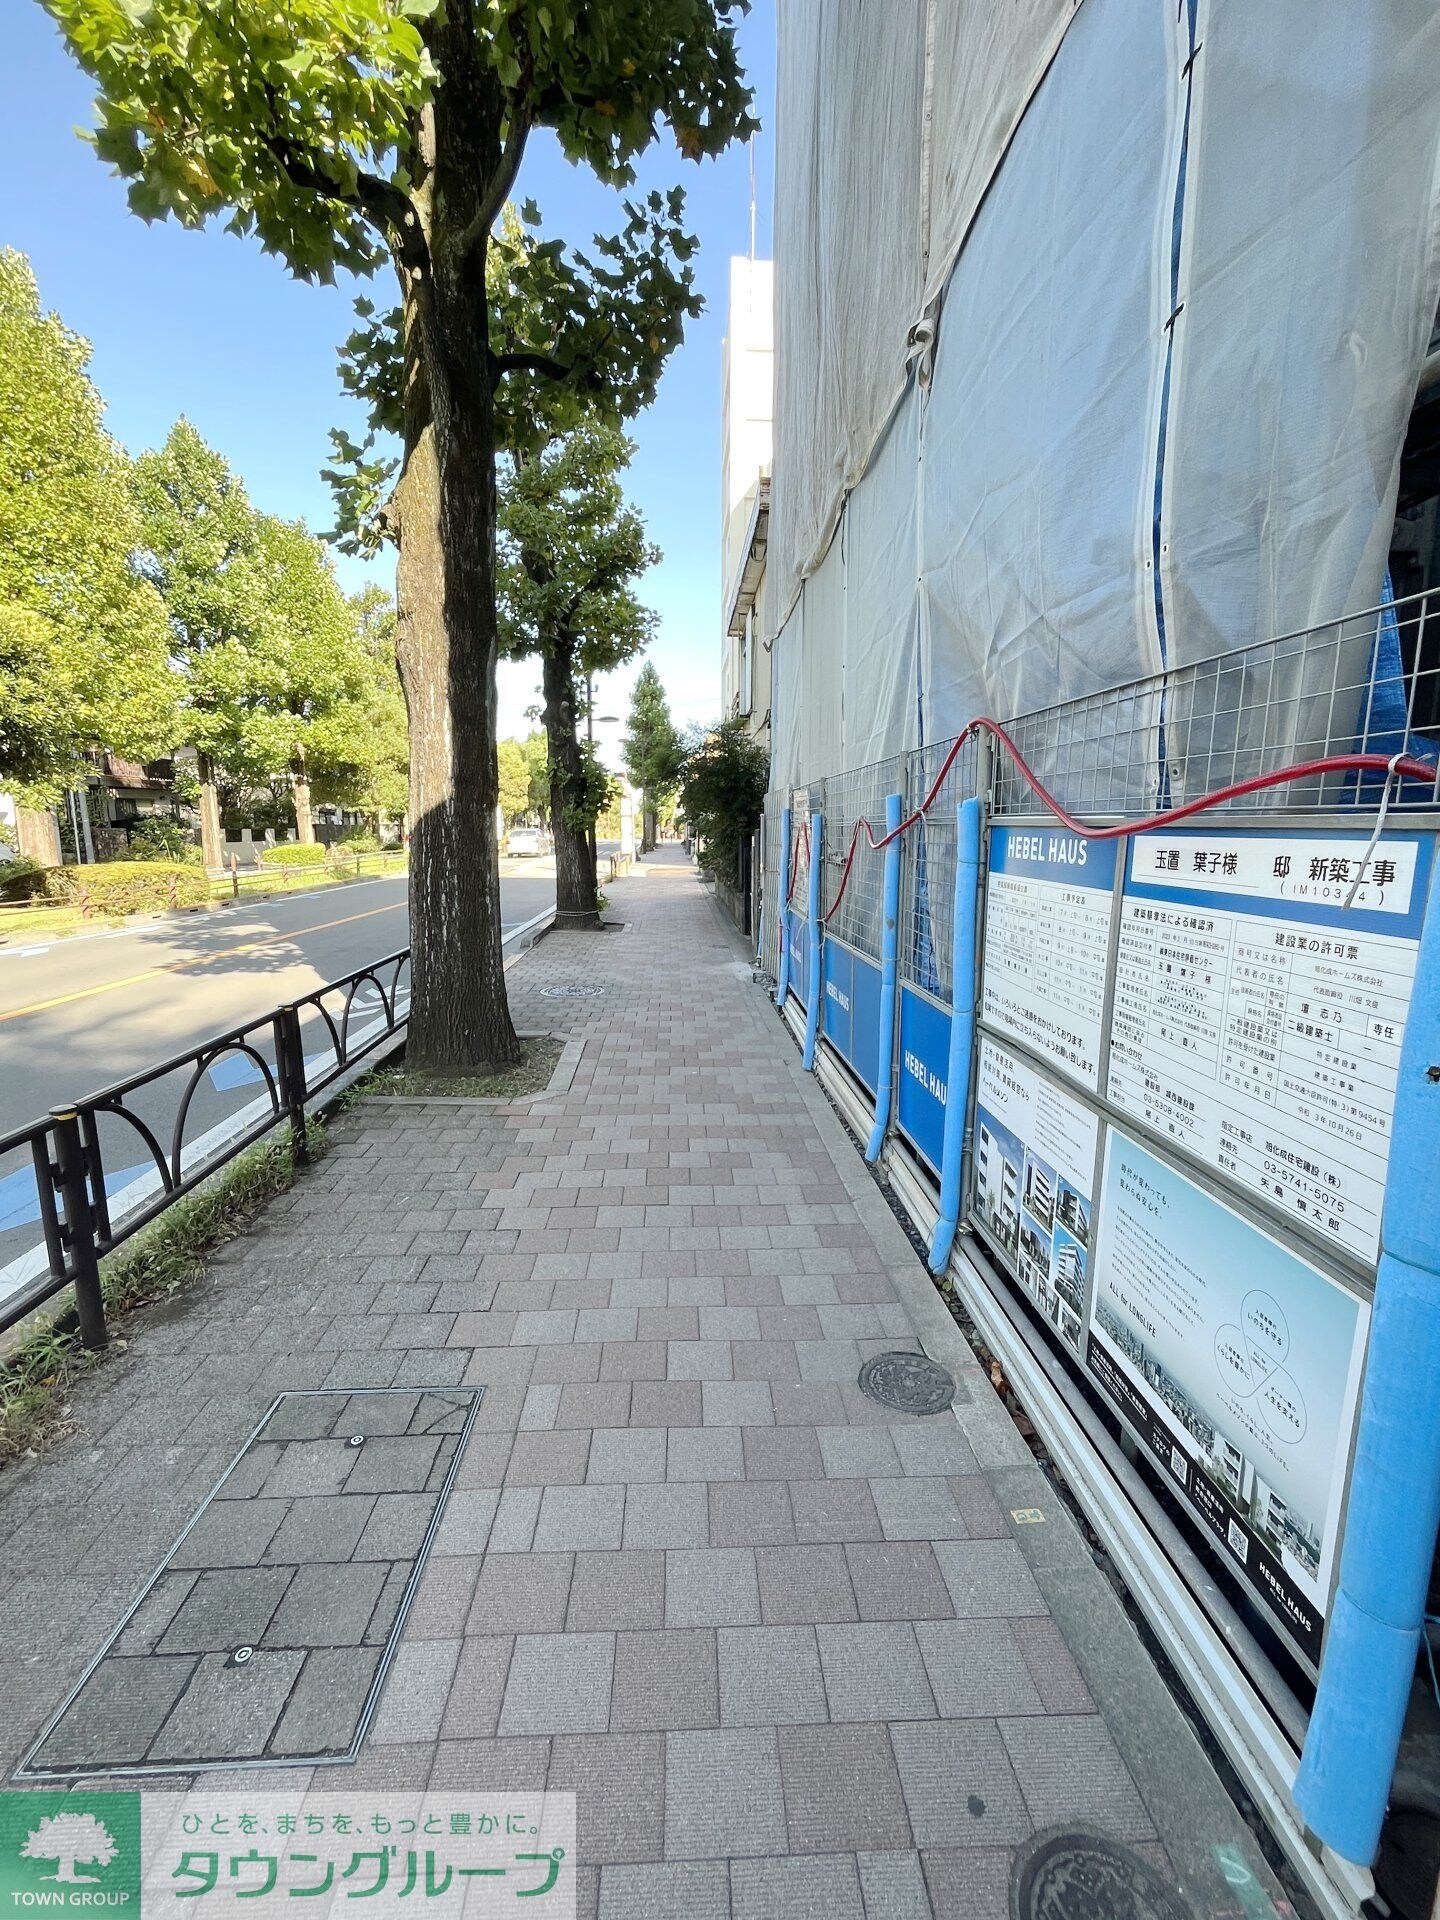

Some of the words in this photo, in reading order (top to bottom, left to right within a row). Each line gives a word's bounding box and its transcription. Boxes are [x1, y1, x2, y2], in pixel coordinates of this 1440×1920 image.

[1007, 836, 1045, 861] HEBEL
[1048, 838, 1088, 865] HAUS
[1155, 850, 1180, 870] 玉置
[1193, 851, 1238, 875] 葉子様
[1273, 855, 1291, 878] 邸
[1309, 857, 1397, 886] 新築工事
[1133, 908, 1214, 932] 建築基準法による確認済
[1237, 947, 1287, 966] 商号又は名称
[1274, 932, 1360, 960] 建設業の許可票
[1235, 966, 1284, 986] 代表者の氏名
[1287, 1018, 1334, 1043] 二級建築士
[1372, 1022, 1396, 1039] 専任
[905, 1049, 929, 1089] HEBEL
[930, 1072, 947, 1106] HAU
[1263, 1159, 1346, 1214] 03-5741-5075
[1109, 1282, 1120, 1299] ALL
[1120, 1293, 1128, 1306] for
[1128, 1302, 1157, 1339] LONGLIFE
[1247, 1311, 1283, 1347] いのちを守る
[1216, 1344, 1251, 1381] くらしを豊かに
[1263, 1390, 1301, 1429] 人生を支える
[1259, 1561, 1286, 1601] HEBEL
[1287, 1597, 1312, 1632] HAUS
